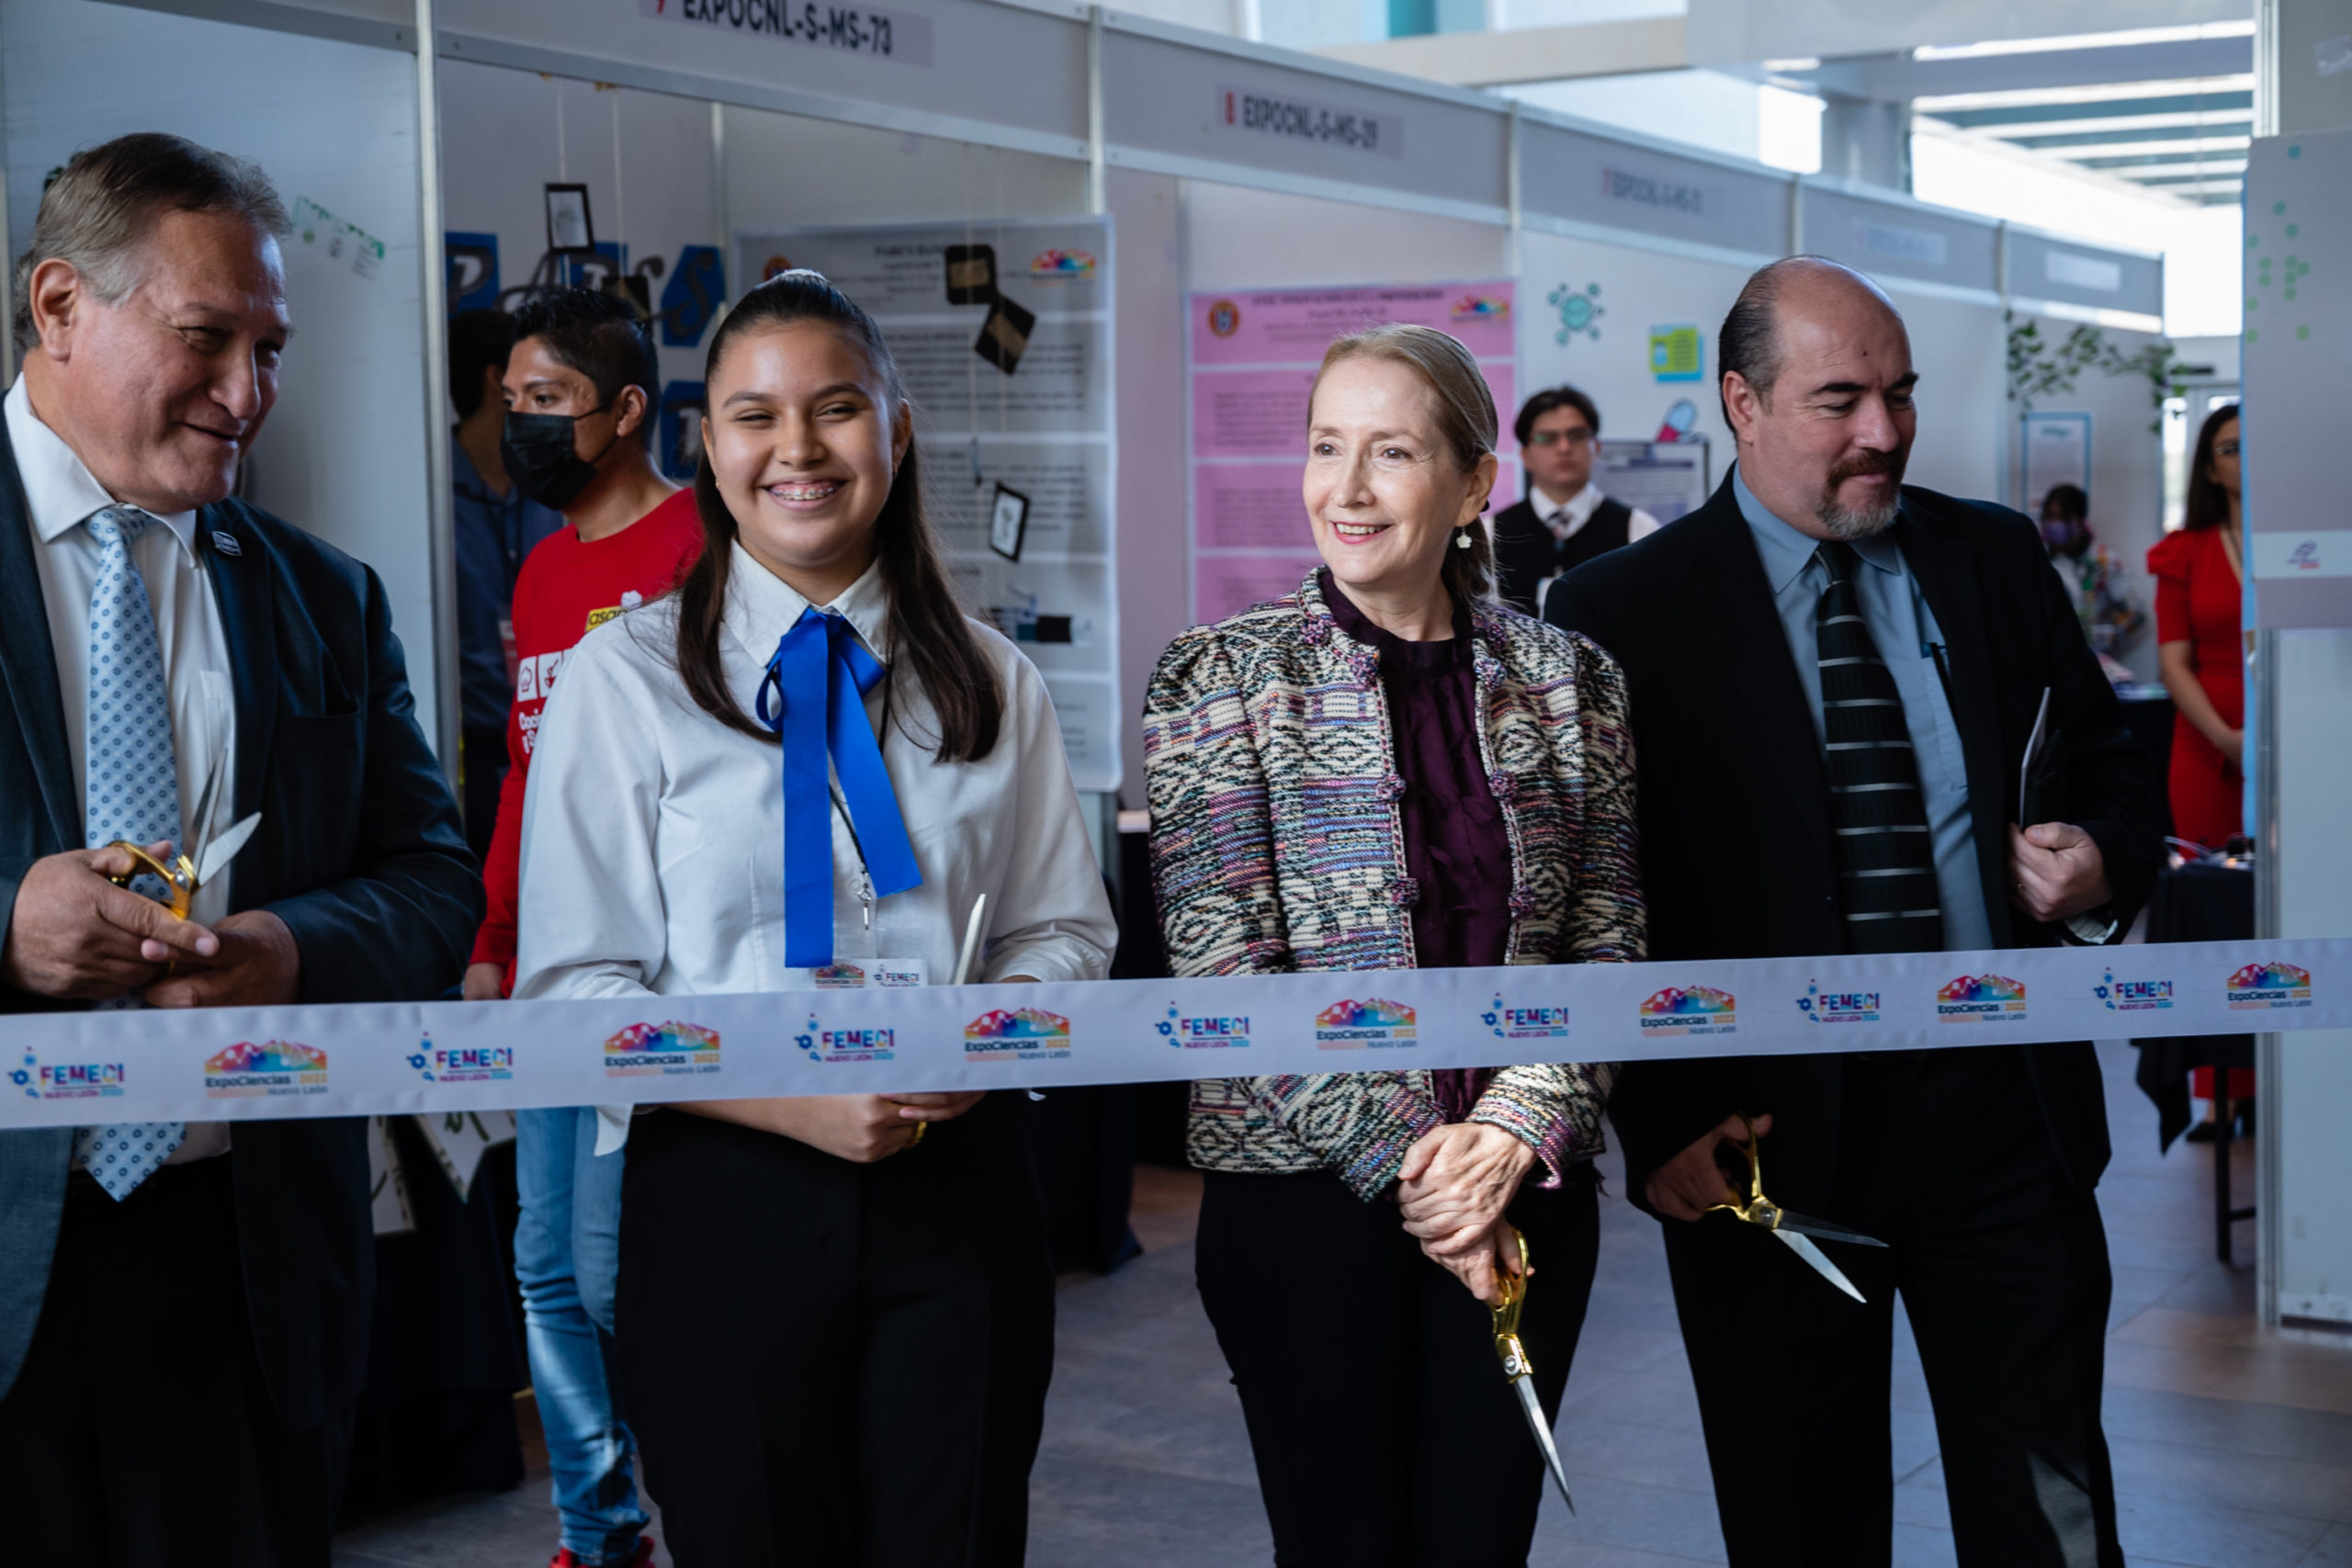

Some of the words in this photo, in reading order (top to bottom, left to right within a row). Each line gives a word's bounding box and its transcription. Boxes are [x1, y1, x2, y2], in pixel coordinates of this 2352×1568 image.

[2116, 981, 2173, 999] FEMECI
[2227, 990, 2286, 1001] ExpoCiencias
[1819, 993, 1880, 1011] FEMECI
[1938, 1003, 1999, 1014] ExpoCiencias
[1505, 1008, 1568, 1026] FEMECI
[1641, 1015, 1707, 1028] ExpoCiencias
[1182, 1017, 1250, 1036] FEMECI
[822, 1029, 894, 1049] FEMECI
[1317, 1029, 1385, 1041] ExpoCiencias
[965, 1040, 1038, 1053] ExpoCiencias
[435, 1047, 513, 1069] FEMECI
[605, 1054, 685, 1067] ExpoCiencias
[40, 1064, 124, 1086] FEMECI
[206, 1075, 290, 1089] ExpoCiencias
